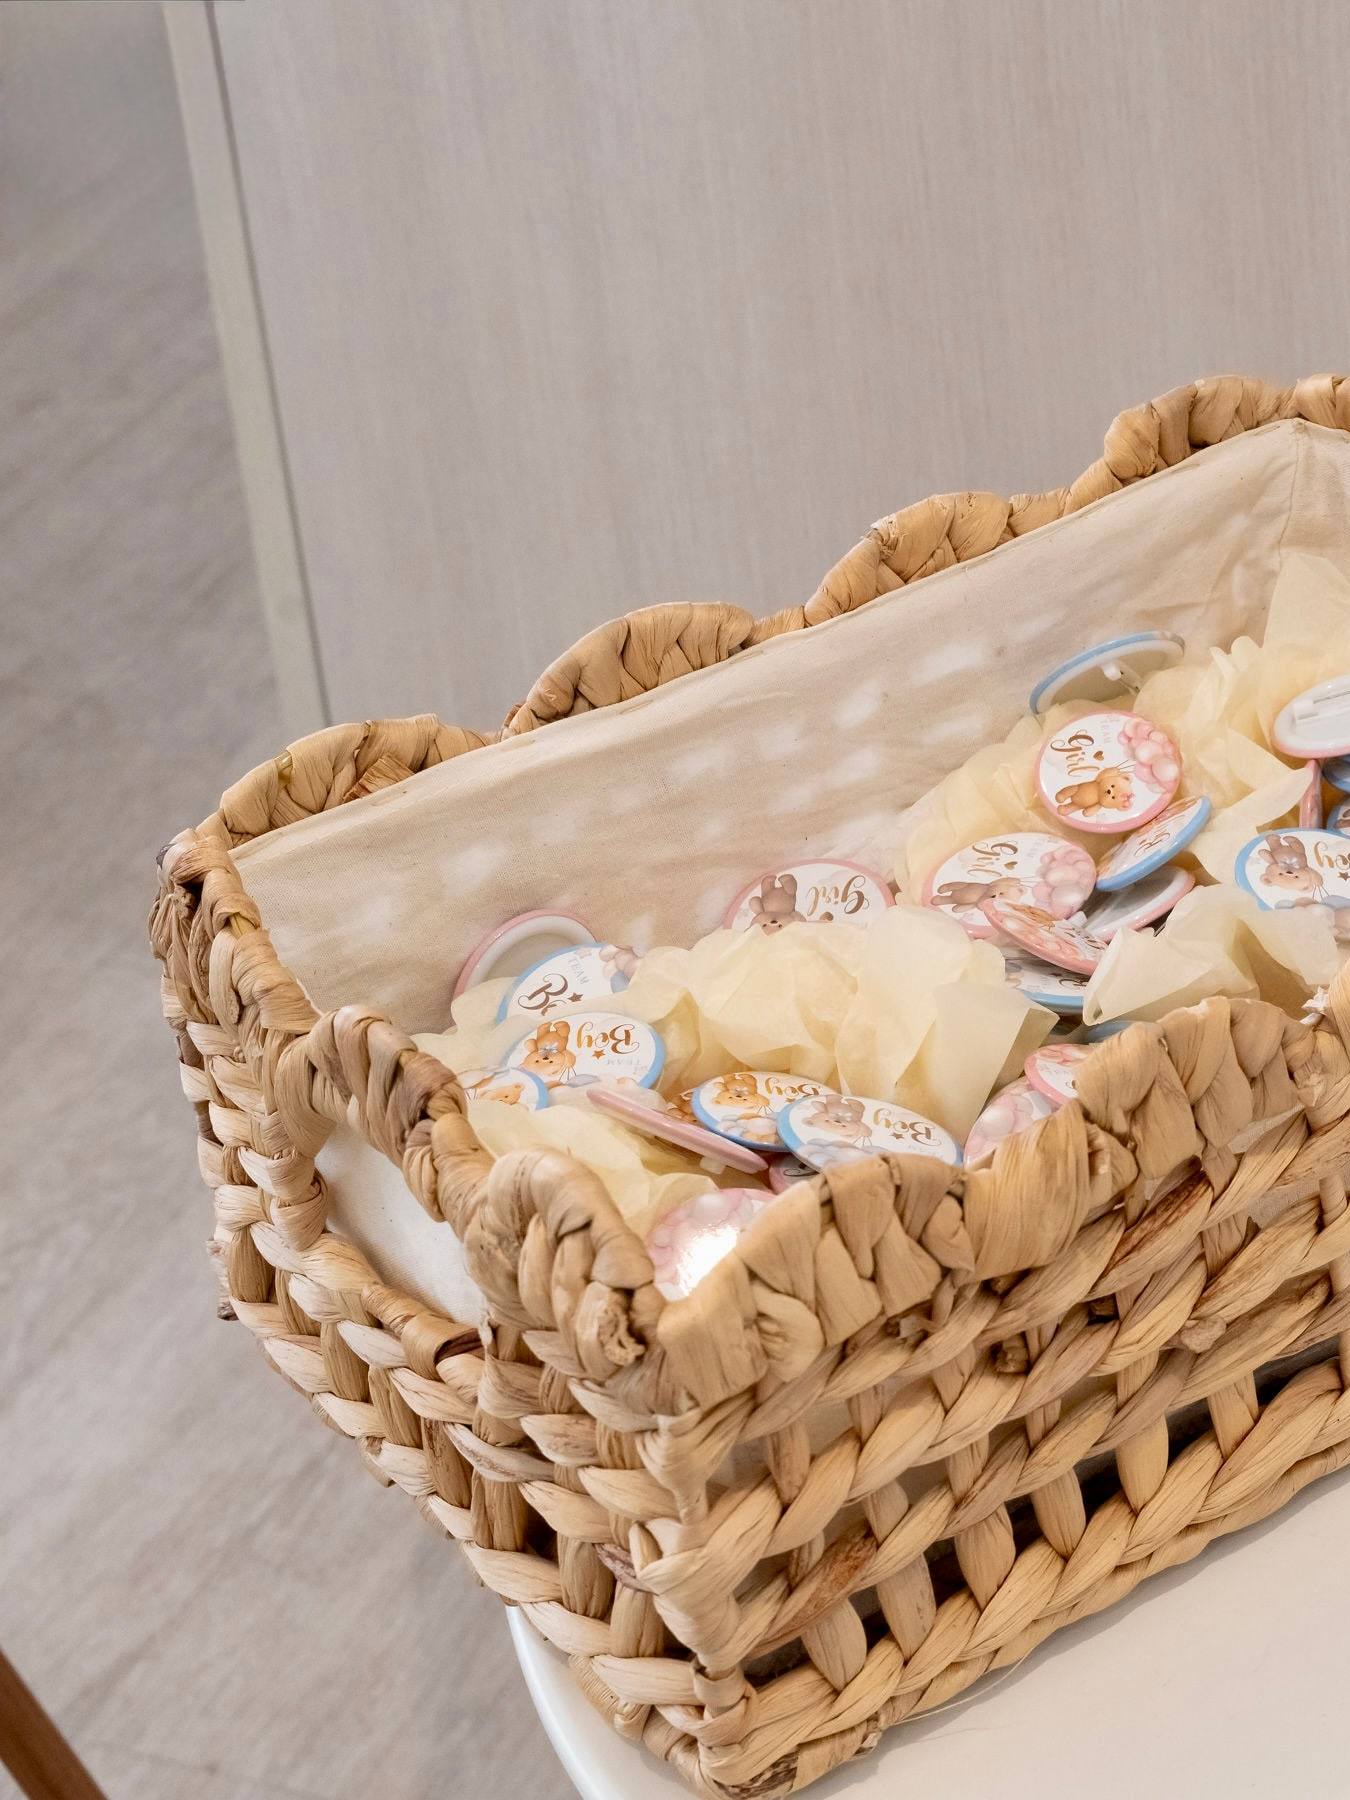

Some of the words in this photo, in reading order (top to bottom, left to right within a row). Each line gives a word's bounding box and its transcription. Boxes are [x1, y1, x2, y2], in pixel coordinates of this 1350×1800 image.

[1050, 729, 1100, 778] Girl
[966, 840, 1018, 877] Girl
[805, 875, 869, 916] Girl
[577, 1022, 640, 1054] Boy
[873, 1108, 942, 1146] Boy
